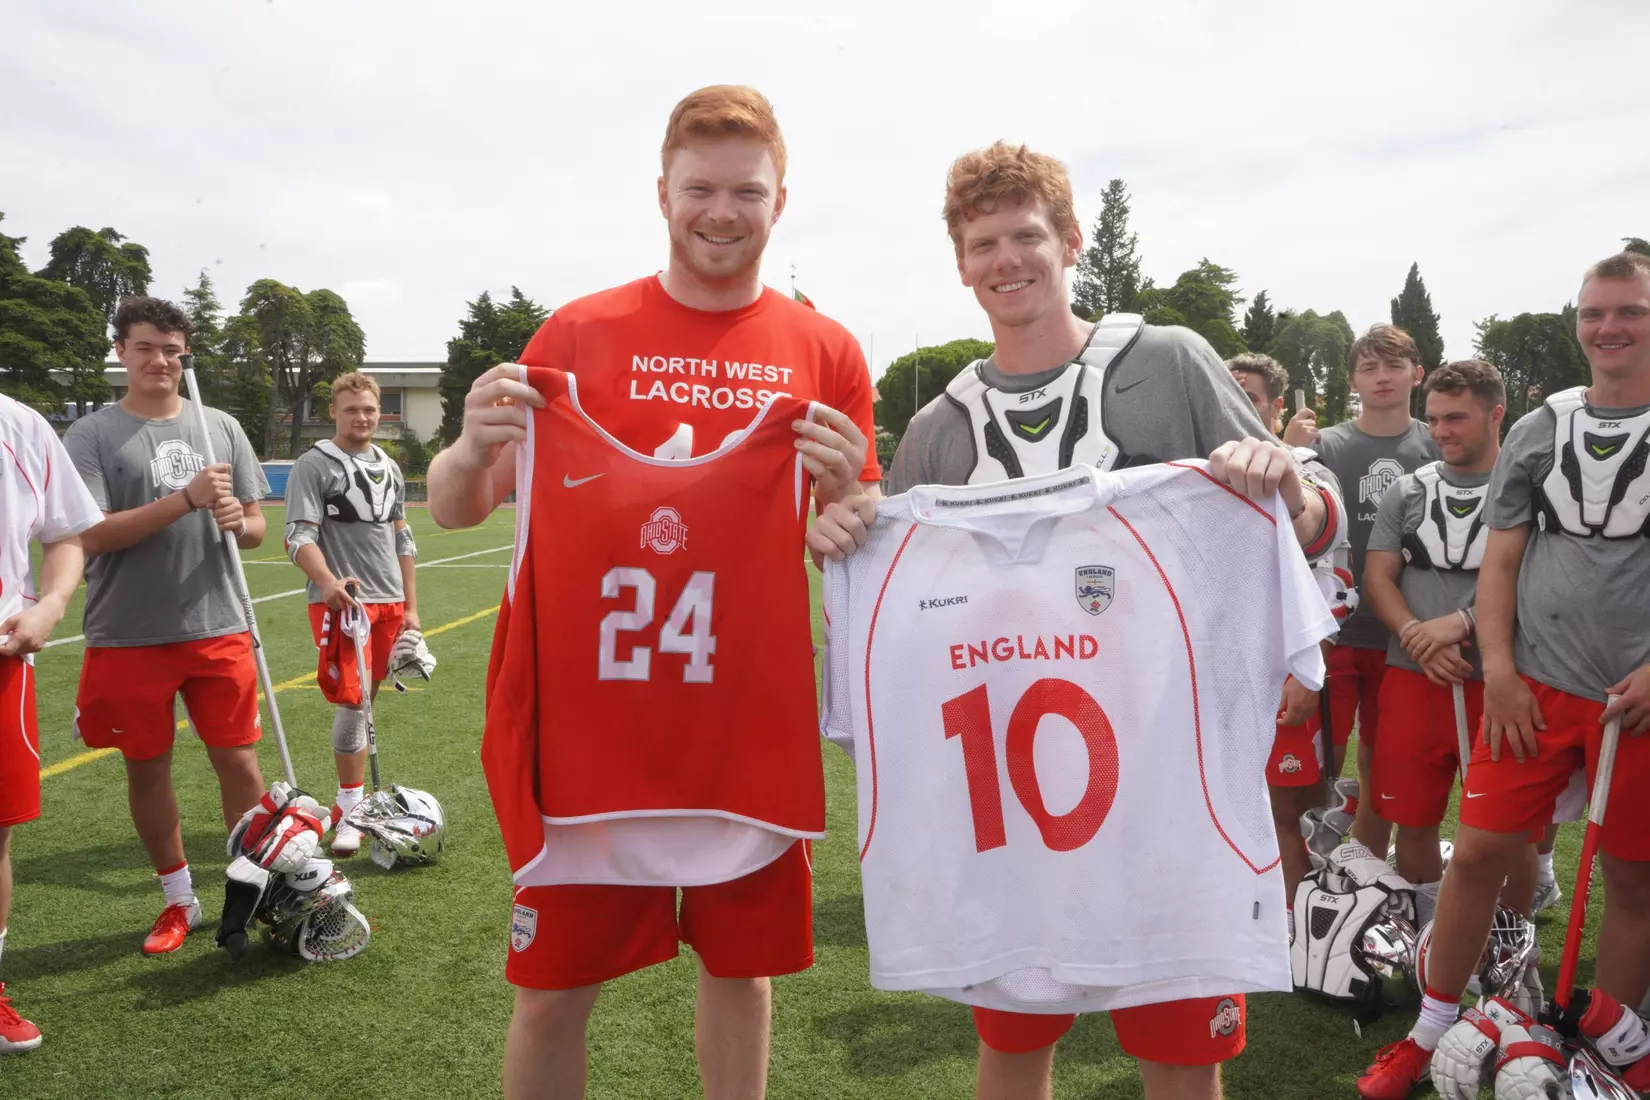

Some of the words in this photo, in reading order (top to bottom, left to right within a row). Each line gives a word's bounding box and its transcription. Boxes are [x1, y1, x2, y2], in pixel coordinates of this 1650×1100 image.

[631, 355, 717, 378] NORTH
[724, 361, 793, 385] WEST
[629, 380, 793, 410] LACROSS
[1019, 388, 1047, 404] STX
[640, 522, 662, 549] OHIO
[661, 519, 689, 551] STATE
[1078, 568, 1112, 577] ENGLAND
[928, 595, 968, 609] KUKRI
[598, 566, 717, 684] 24
[949, 634, 1099, 670] ENGLAND
[941, 677, 1120, 854] 10
[294, 870, 318, 882] STX
[1347, 869, 1358, 881] STX
[1319, 894, 1339, 904] STX
[1475, 1039, 1490, 1054] STX
